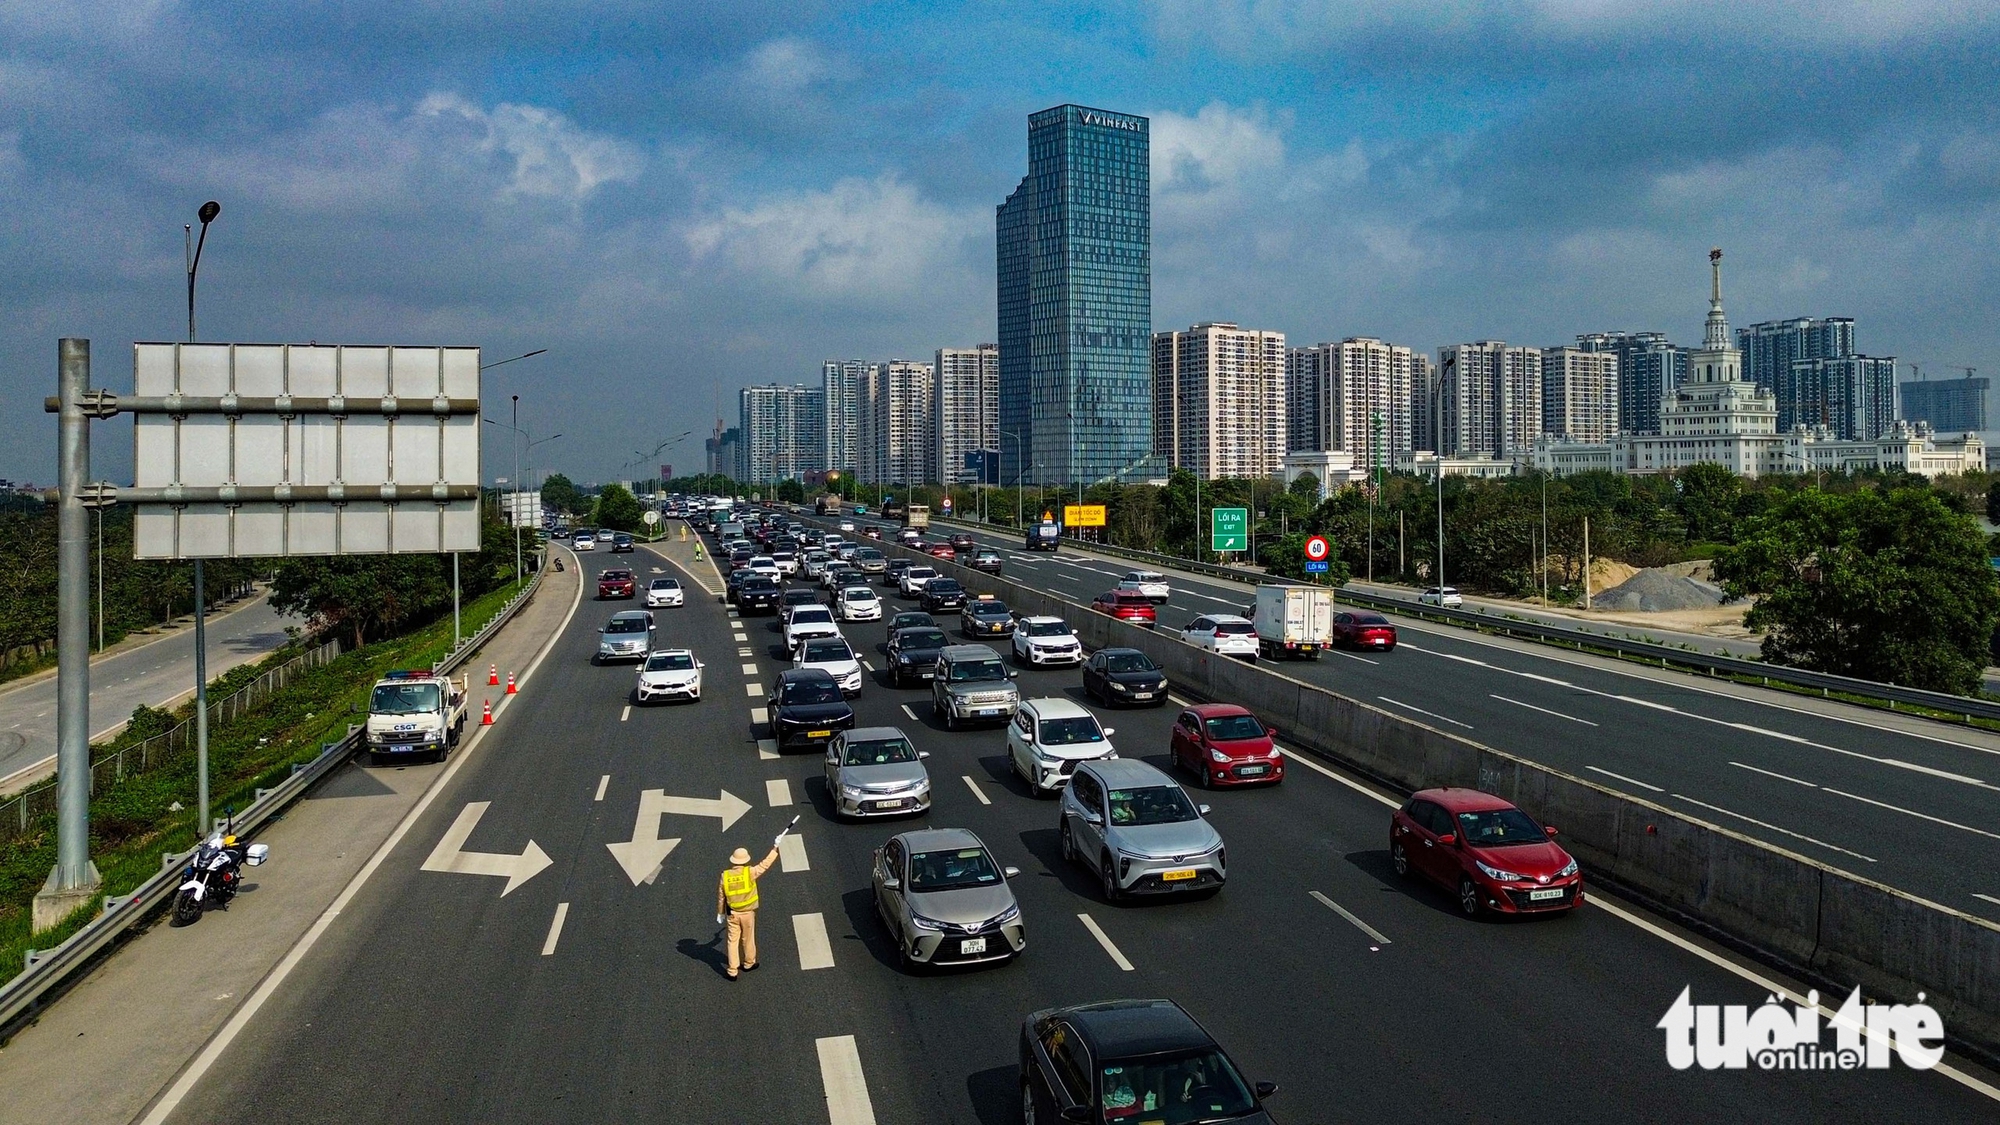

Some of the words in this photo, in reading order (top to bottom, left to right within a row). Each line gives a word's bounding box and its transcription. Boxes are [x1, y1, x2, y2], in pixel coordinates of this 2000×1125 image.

[1093, 113, 1141, 132] VINFAST
[1218, 512, 1229, 522] LỐI
[1312, 543, 1322, 553] 60
[1308, 562, 1317, 570] LỐI
